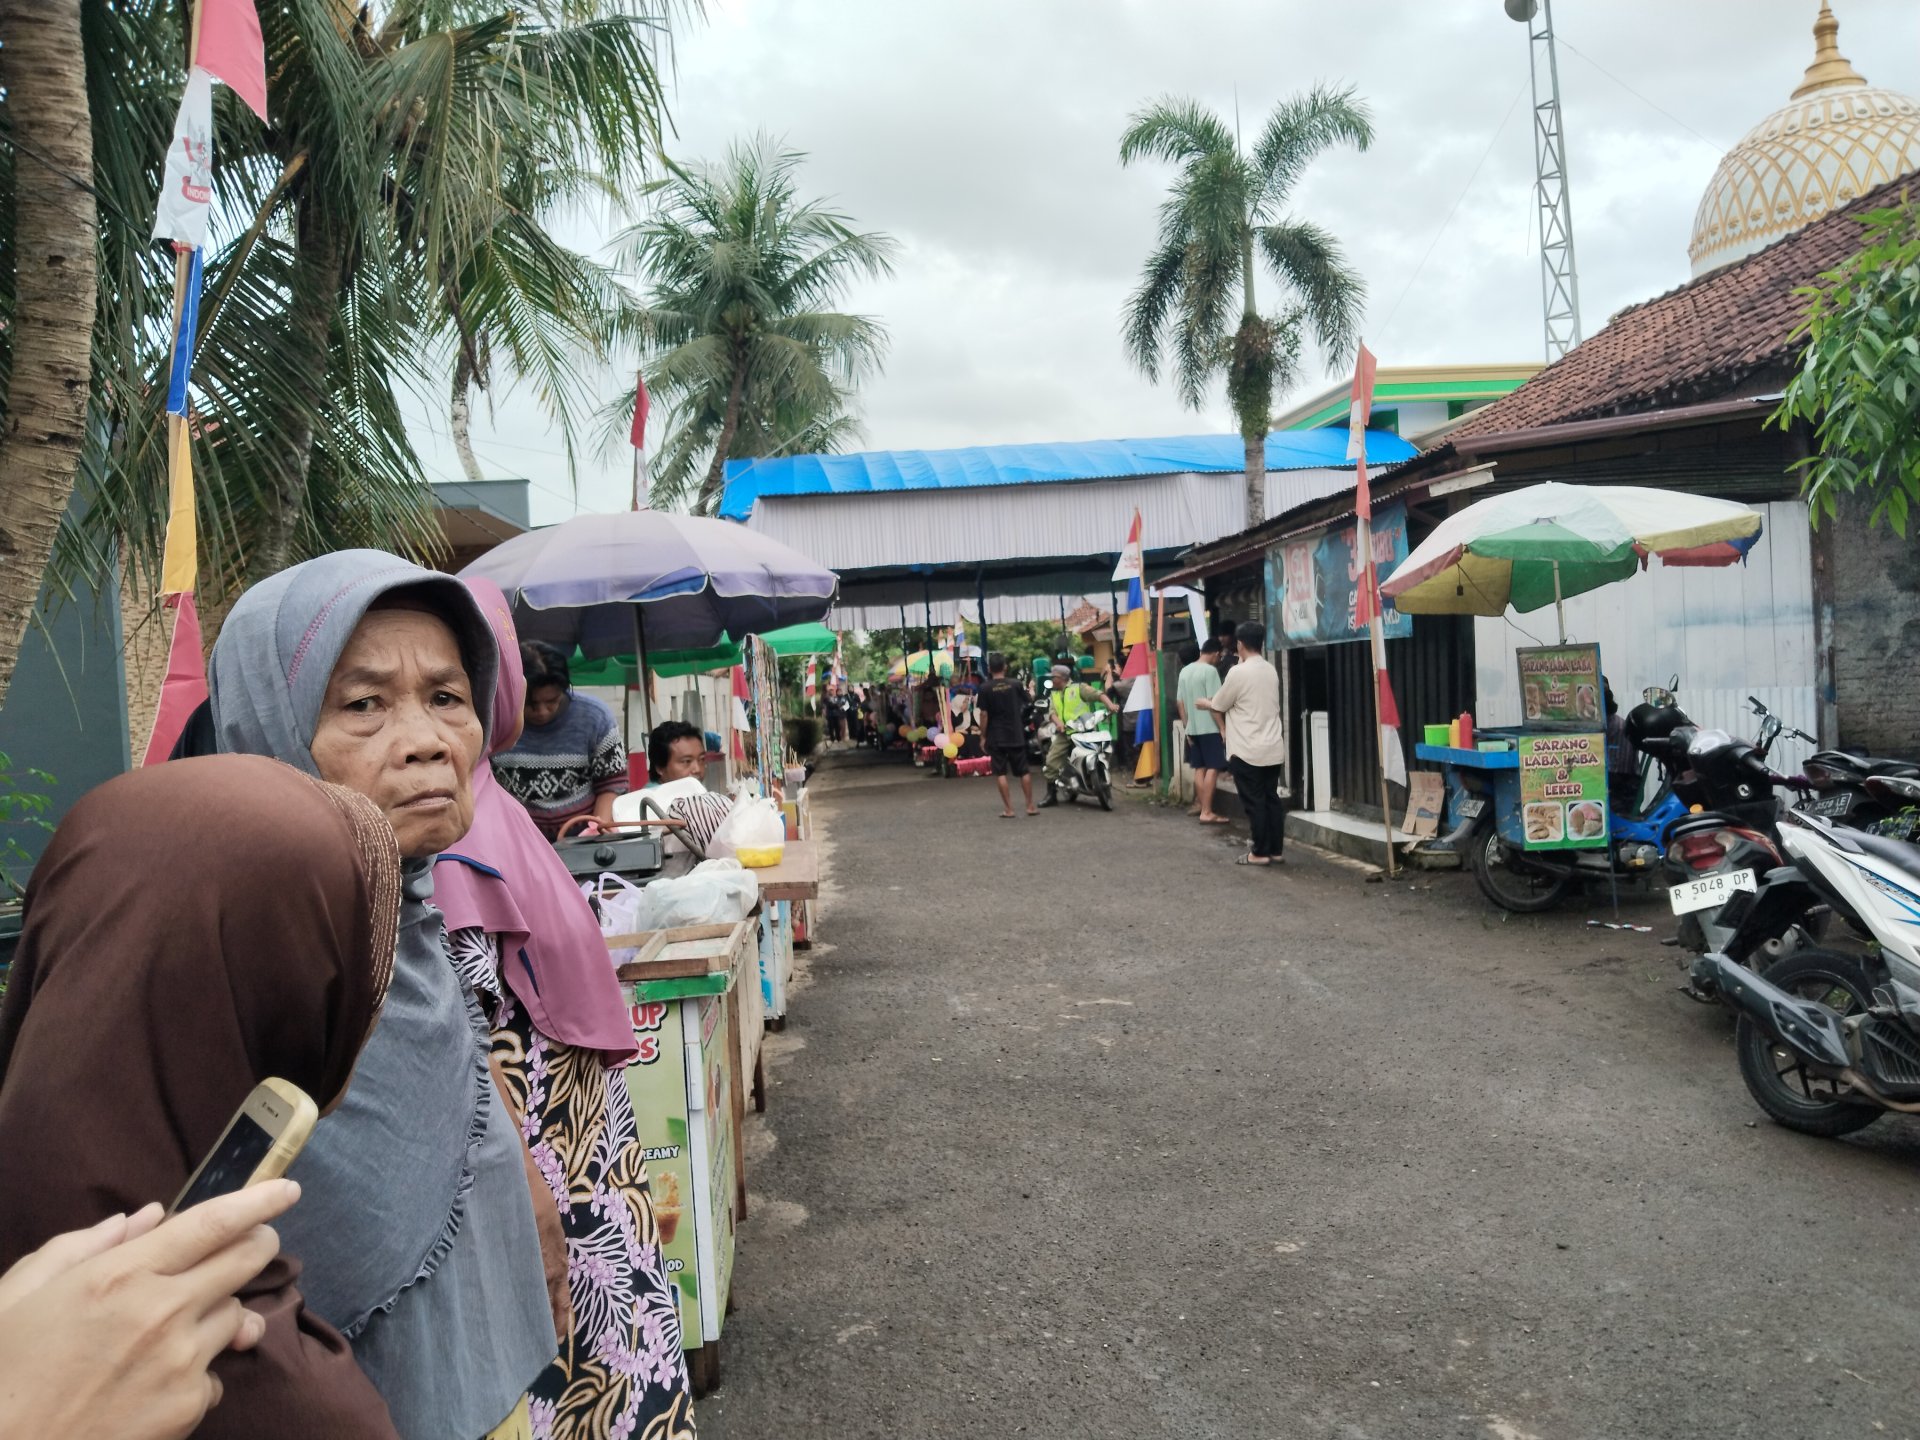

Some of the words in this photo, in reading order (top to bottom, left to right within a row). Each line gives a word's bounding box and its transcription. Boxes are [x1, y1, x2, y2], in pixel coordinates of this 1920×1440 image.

[1534, 739, 1589, 751] SARANG
[1524, 754, 1560, 768] LABA
[1563, 753, 1599, 766] LABA
[1557, 769, 1568, 781] &
[1545, 783, 1582, 796] LEKER
[1674, 888, 1682, 900] R
[1733, 872, 1749, 885] DP
